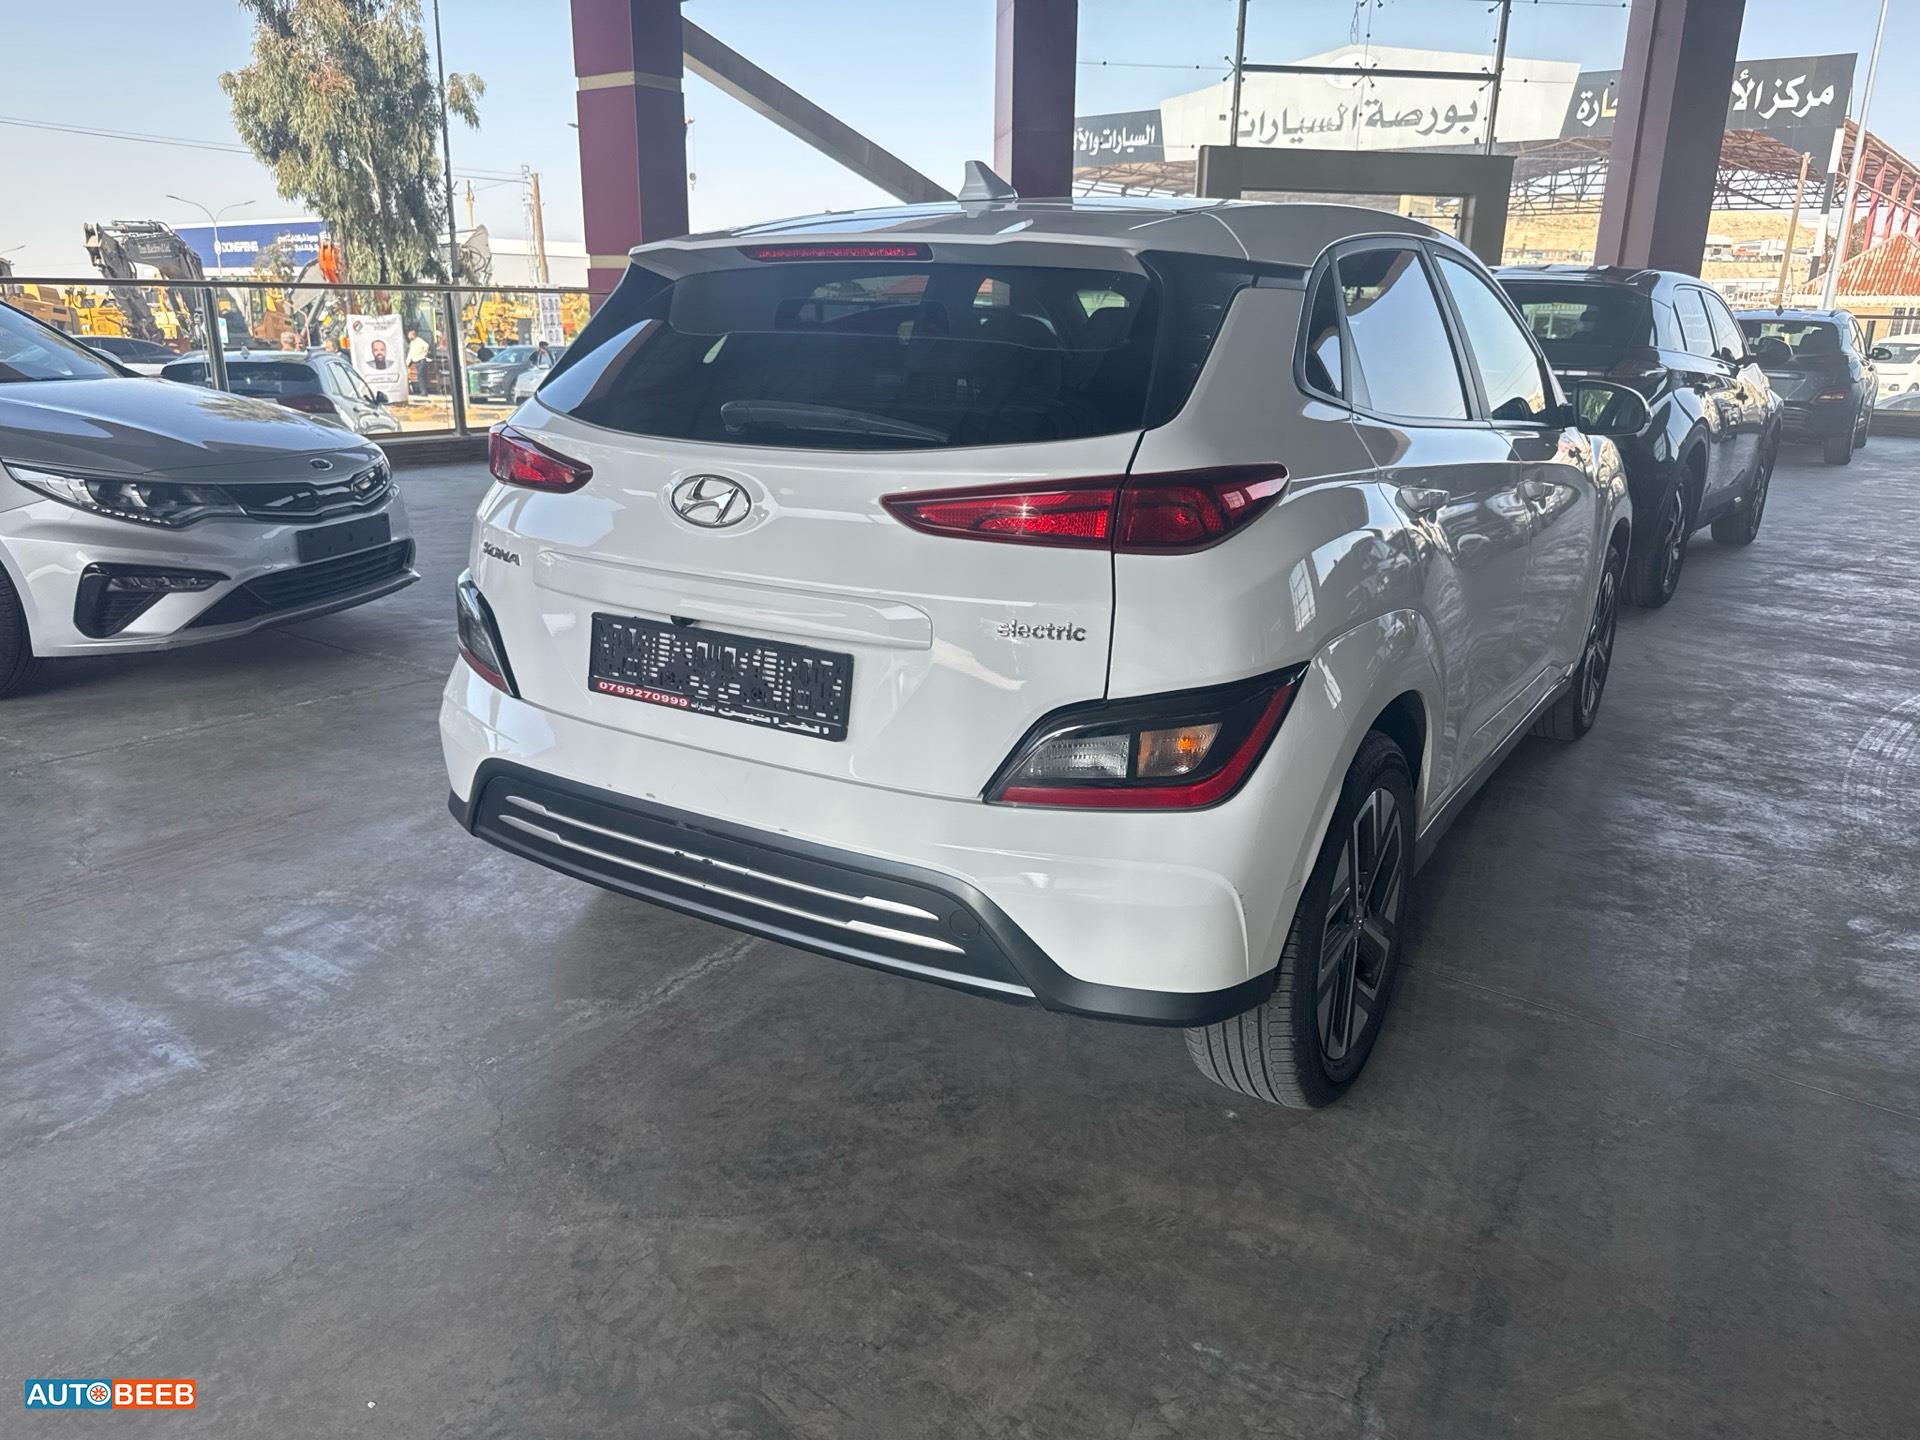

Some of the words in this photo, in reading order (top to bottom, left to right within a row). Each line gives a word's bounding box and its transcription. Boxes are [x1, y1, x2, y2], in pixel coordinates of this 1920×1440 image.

[1731, 68, 1764, 111] الأ
[1758, 74, 1835, 120] مركز
[1364, 98, 1478, 136] بورصة
[1099, 124, 1156, 154] السيارات
[997, 619, 1087, 642] electric
[599, 680, 689, 708] 0799270999
